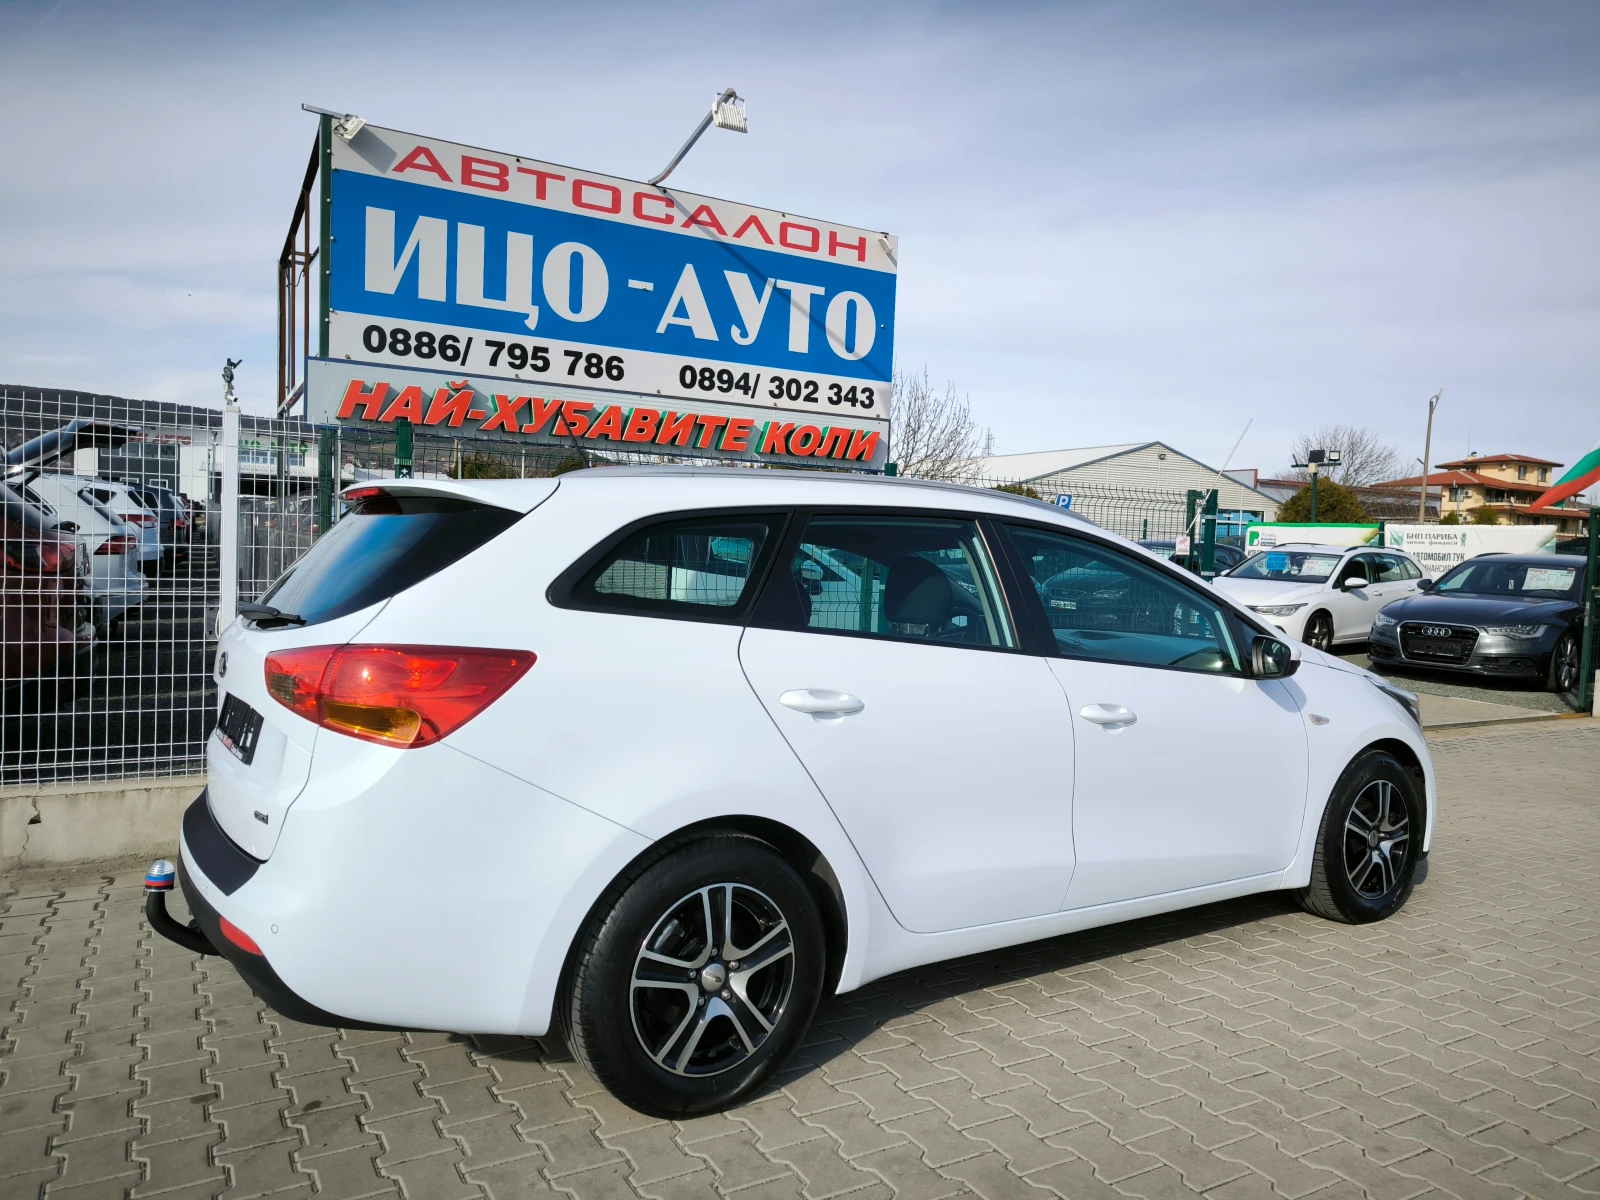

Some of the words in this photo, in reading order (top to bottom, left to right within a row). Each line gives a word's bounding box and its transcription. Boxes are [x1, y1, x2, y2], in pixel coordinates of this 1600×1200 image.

[392, 146, 867, 262] АВТОСАЛОН
[362, 324, 473, 366] 0886/
[485, 339, 550, 373] 795
[563, 350, 625, 381] 786
[679, 365, 761, 398] 0894/
[768, 376, 819, 403] 302
[827, 383, 875, 409] 343
[336, 379, 754, 452] НАЙ-ХУБАВИТЕ
[757, 420, 880, 462] КОЛИ
[1058, 495, 1069, 507] P
